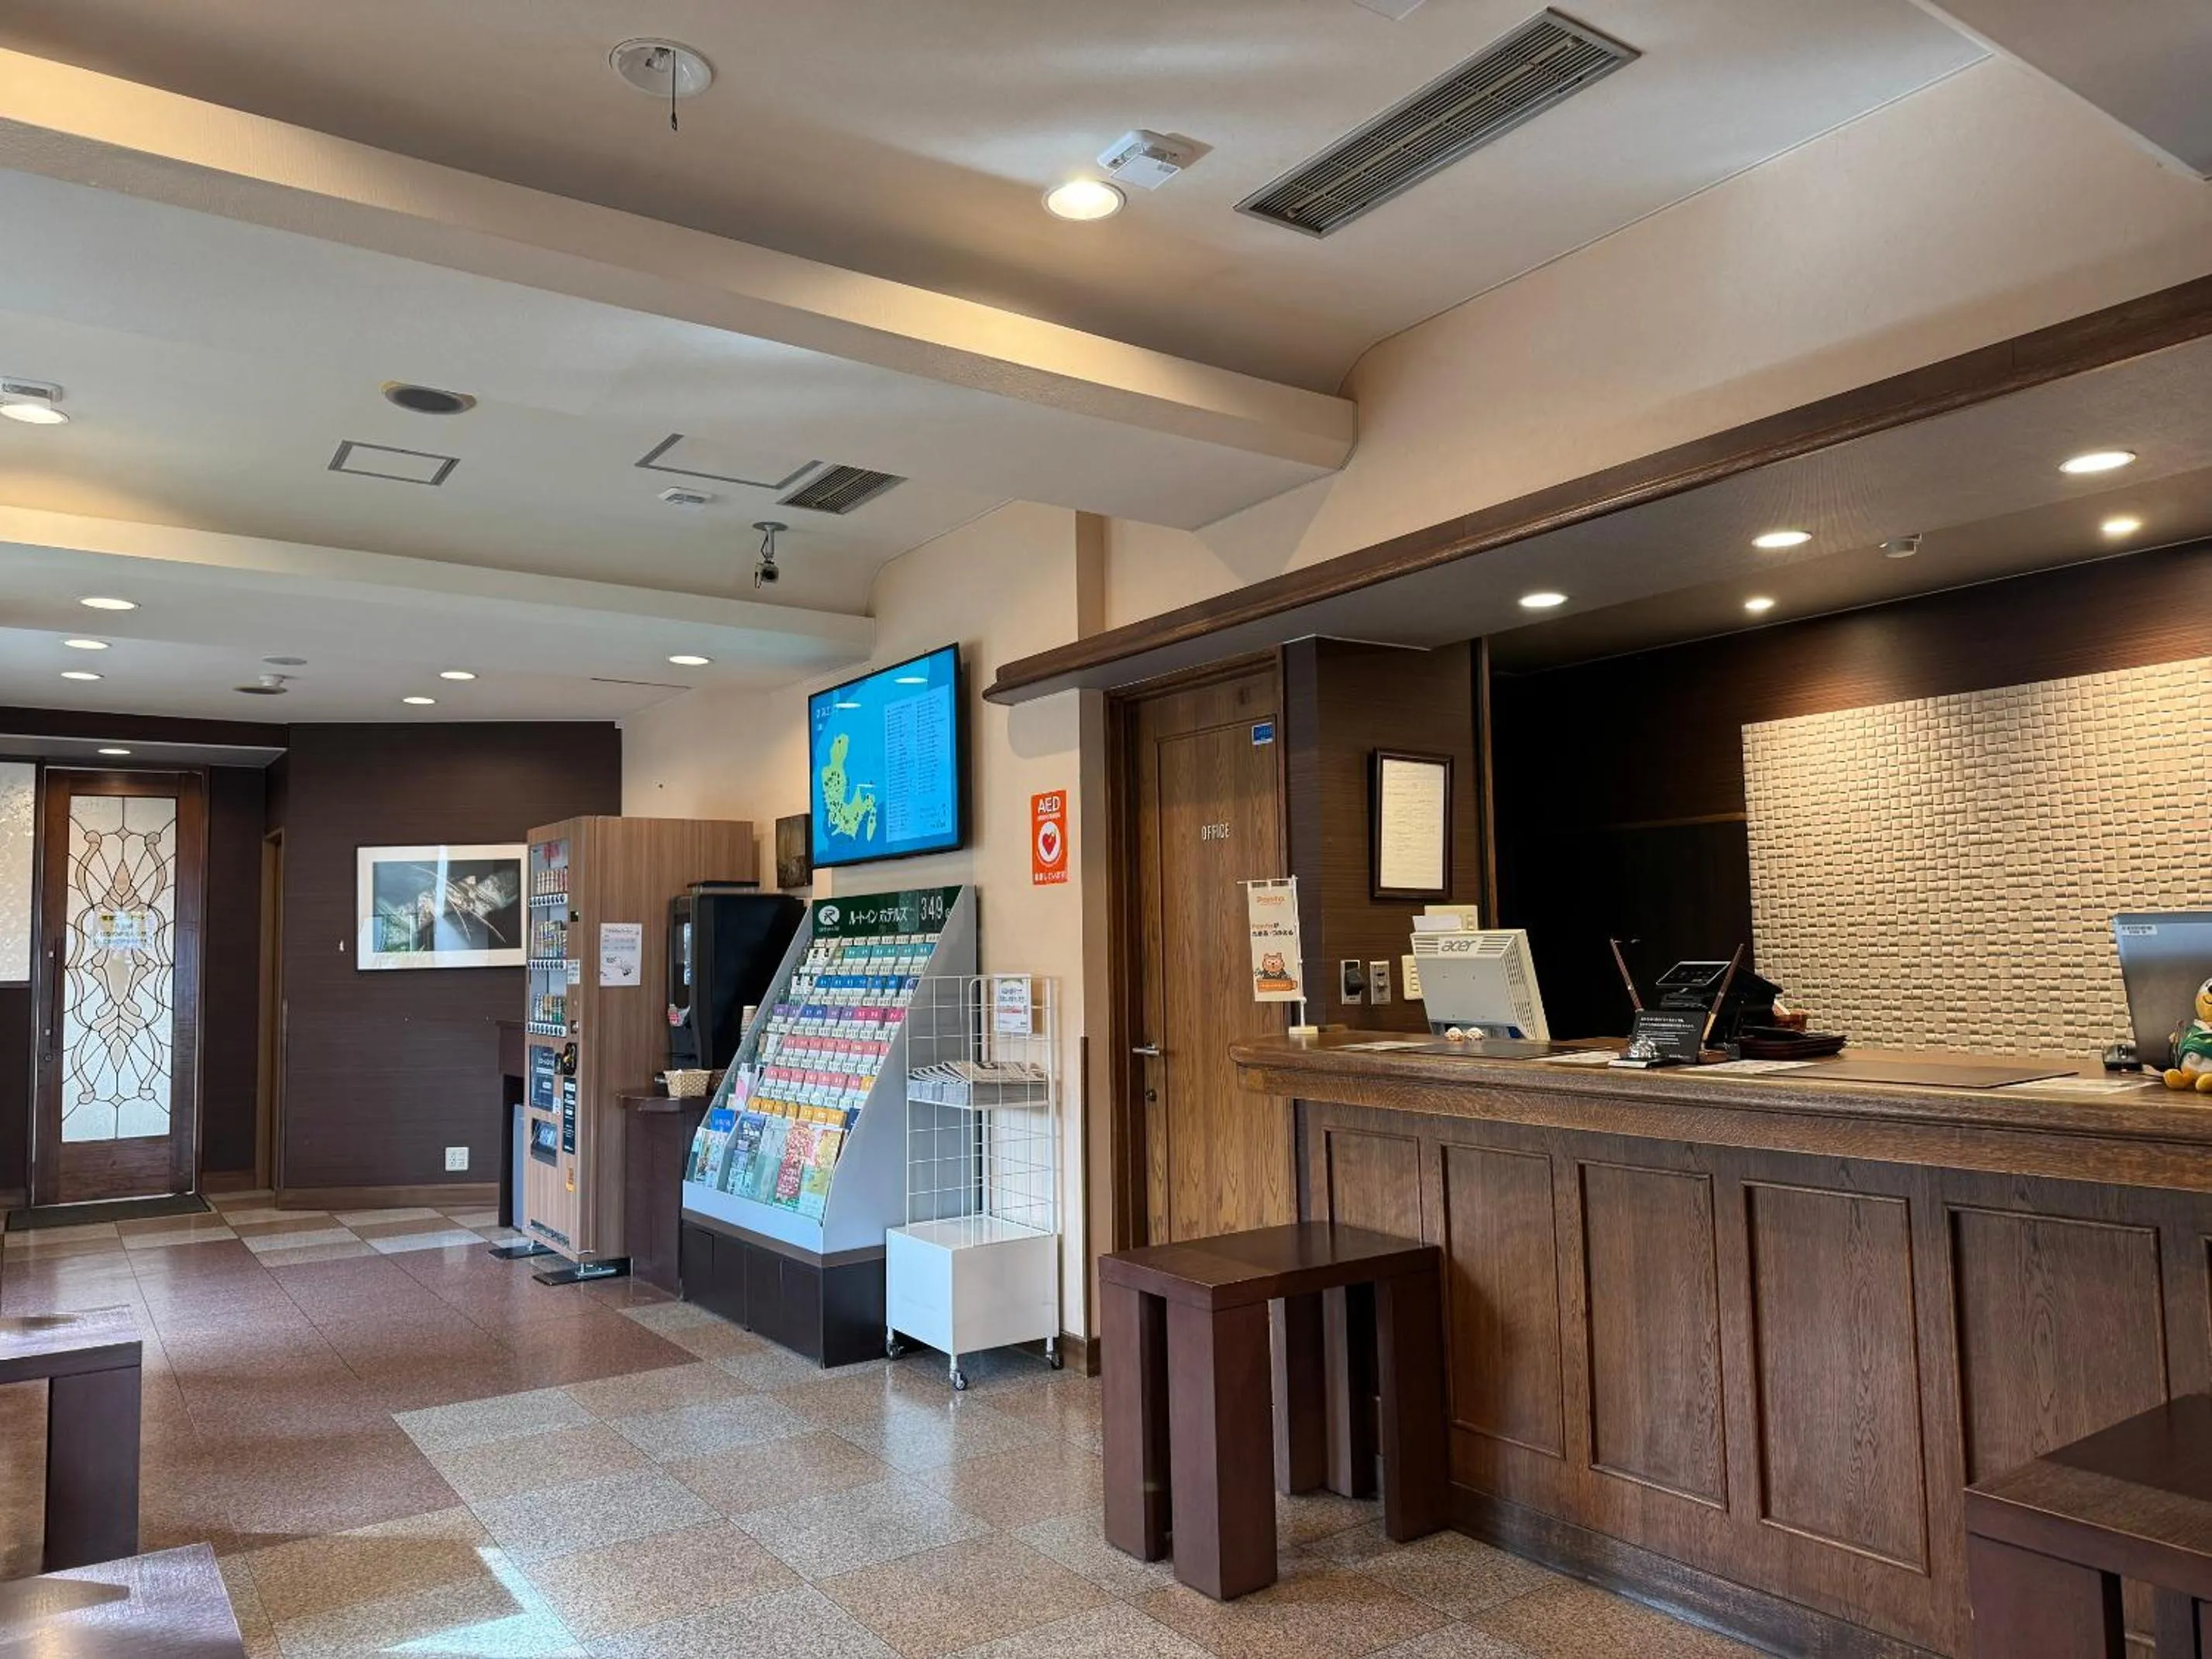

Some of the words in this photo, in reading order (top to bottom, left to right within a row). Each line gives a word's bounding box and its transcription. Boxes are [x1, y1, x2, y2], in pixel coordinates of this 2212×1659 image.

[1038, 796, 1060, 813] AED
[1201, 823, 1231, 840] OFFICE
[1441, 940, 1477, 952] acer
